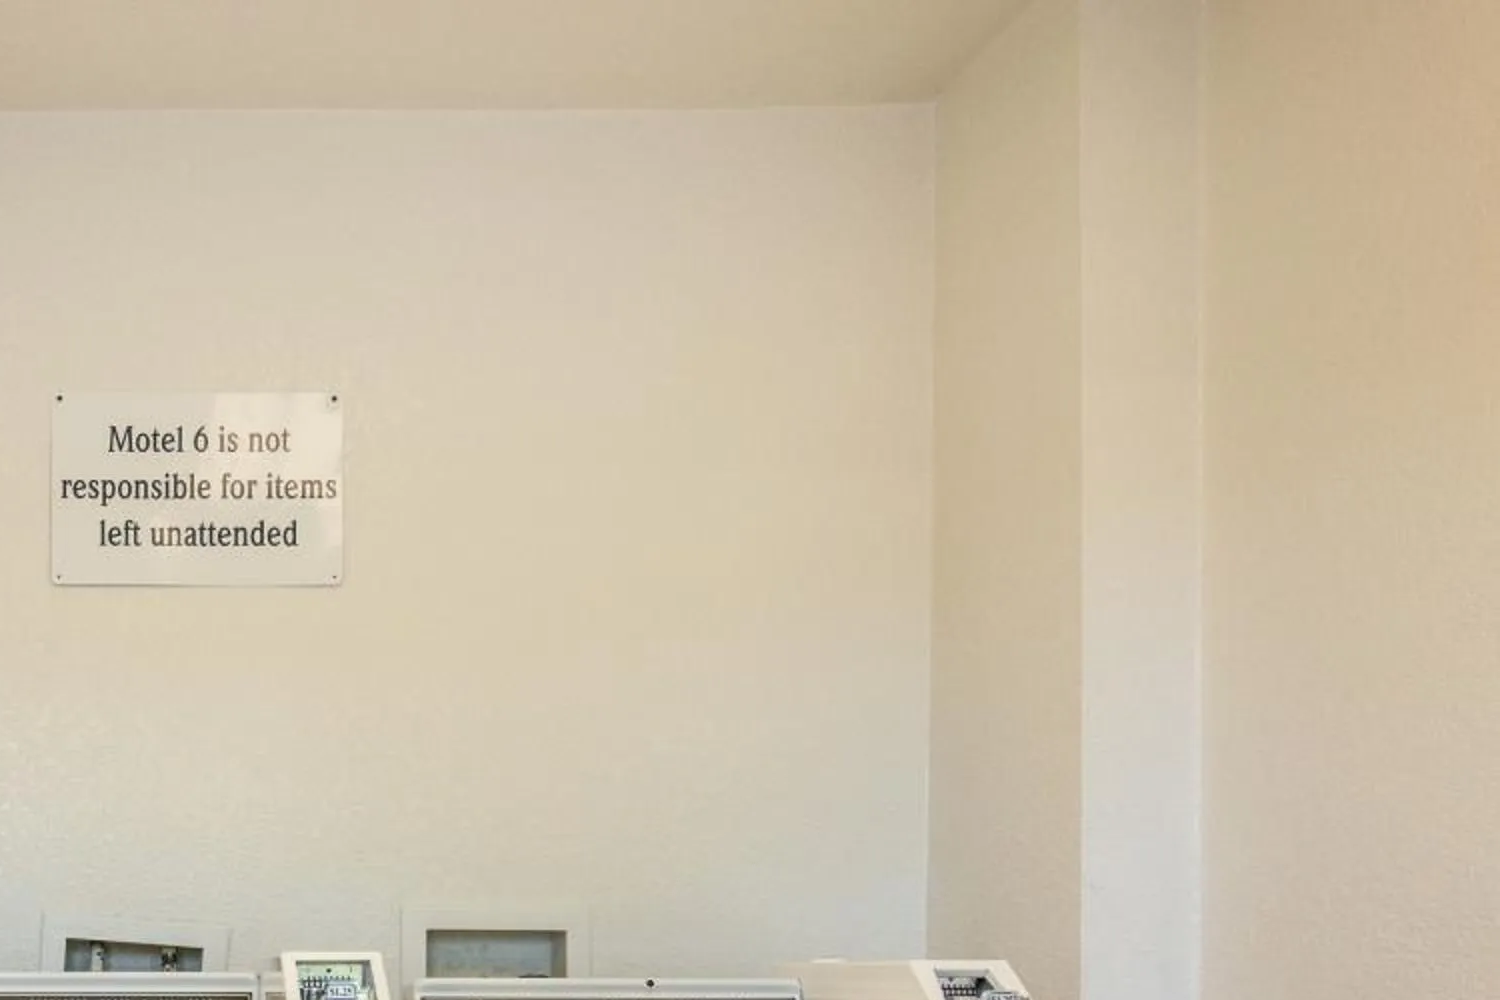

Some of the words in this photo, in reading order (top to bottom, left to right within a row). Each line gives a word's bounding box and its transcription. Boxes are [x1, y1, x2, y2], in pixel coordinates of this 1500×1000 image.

[108, 425, 184, 453] Motel
[193, 425, 209, 453] 6
[218, 426, 239, 453] is
[249, 428, 291, 453] not
[60, 472, 211, 506] responsible
[220, 472, 257, 499] for
[265, 472, 337, 499] items
[99, 520, 141, 546] left
[150, 520, 299, 546] unattended
